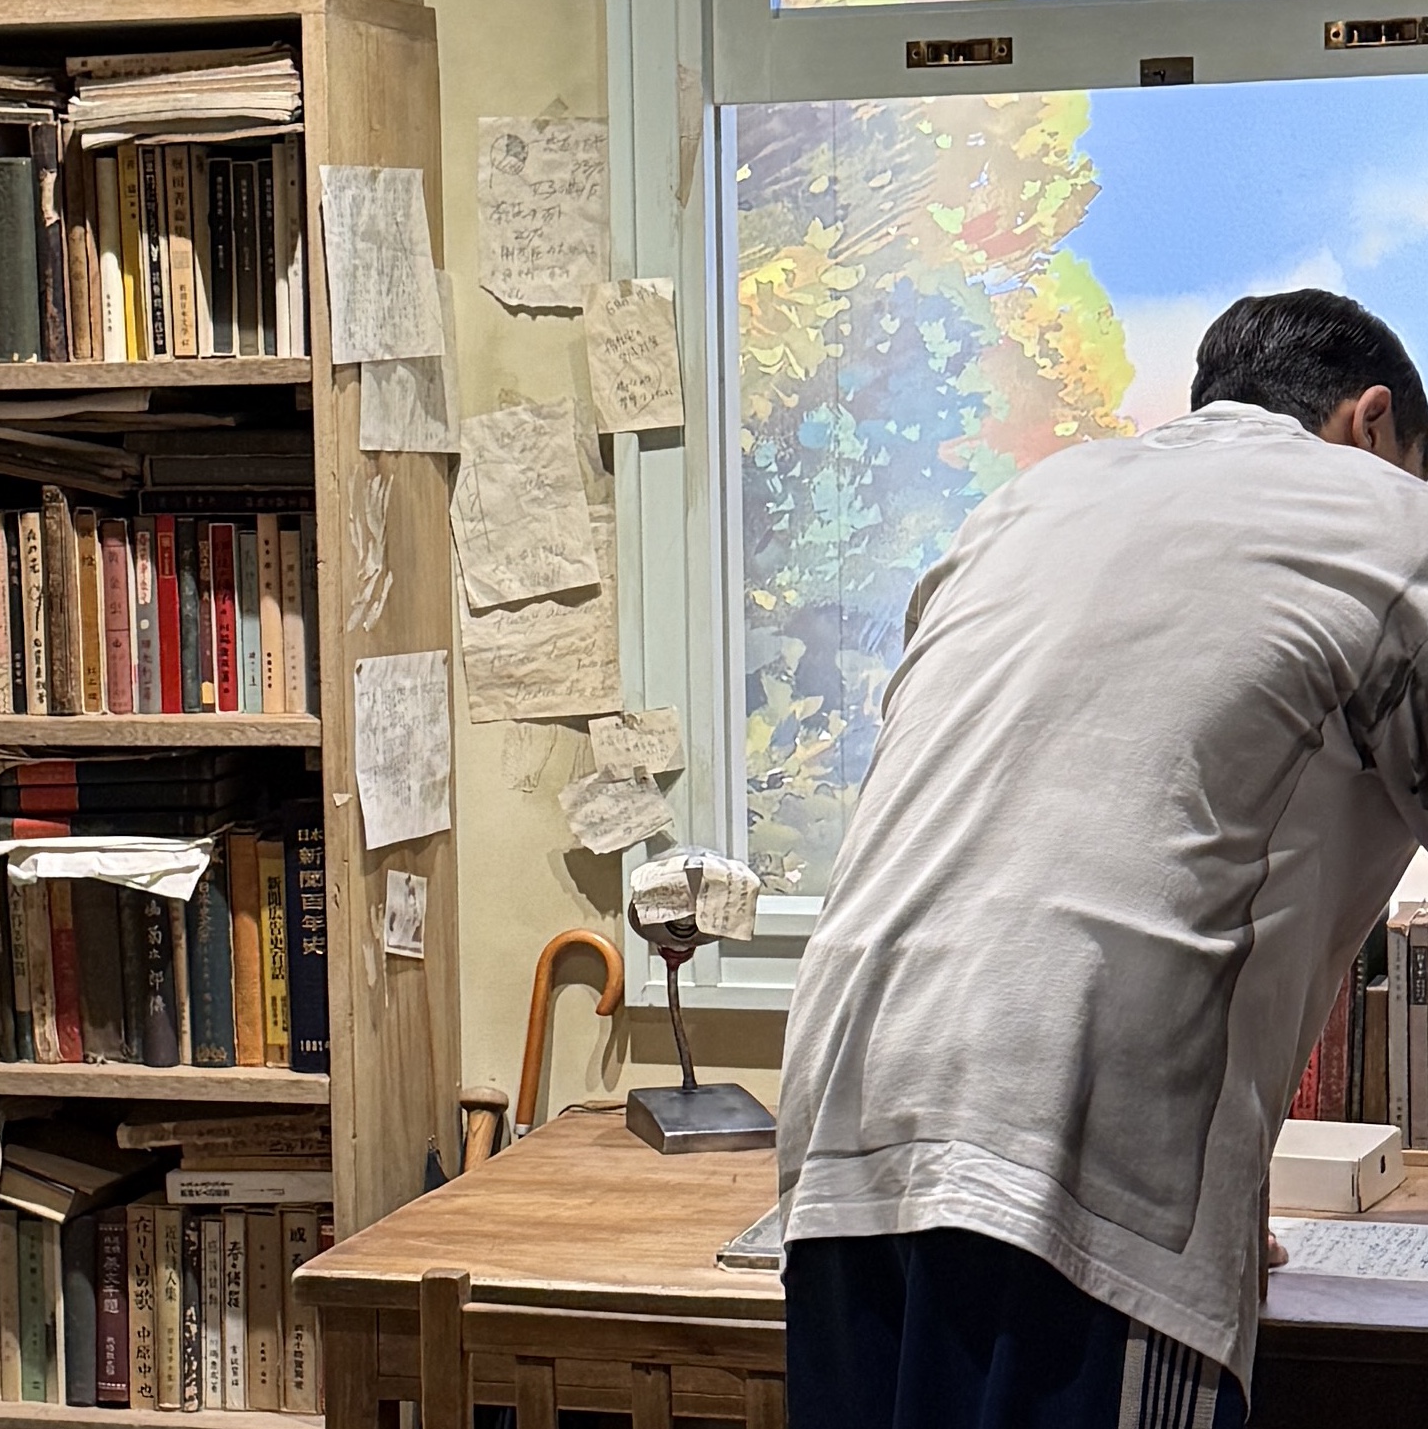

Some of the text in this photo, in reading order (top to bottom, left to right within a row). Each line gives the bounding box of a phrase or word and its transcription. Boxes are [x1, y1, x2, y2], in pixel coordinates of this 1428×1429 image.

[298, 846, 325, 955] 新聞百年史
[134, 1216, 154, 1310] 在りし日の歌
[136, 1326, 154, 1399] 中原中也
